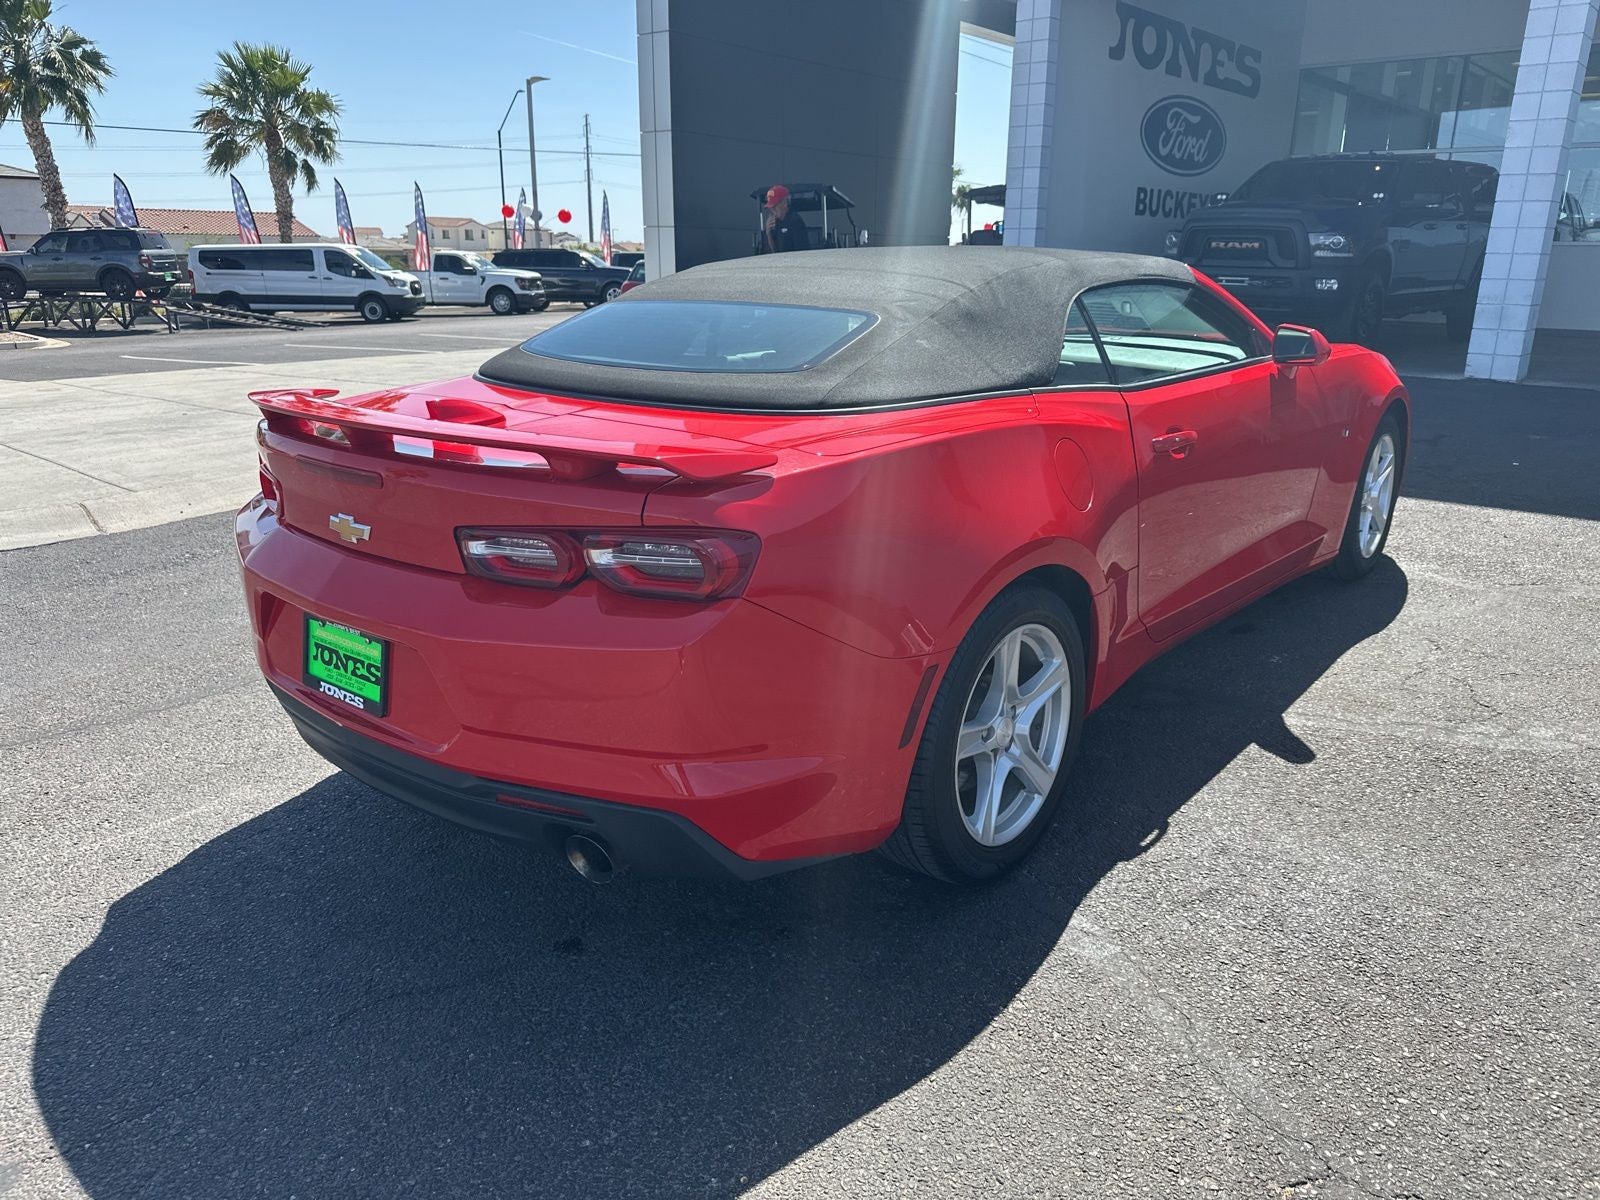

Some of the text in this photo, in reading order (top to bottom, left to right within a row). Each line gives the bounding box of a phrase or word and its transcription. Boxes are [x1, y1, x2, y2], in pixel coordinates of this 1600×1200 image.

[1108, 1, 1262, 99] JONES
[1158, 107, 1212, 162] Ford
[1134, 186, 1217, 219] BUCKEY
[1210, 241, 1260, 249] RAM
[312, 640, 381, 687] JONES
[319, 680, 364, 710] JONES
